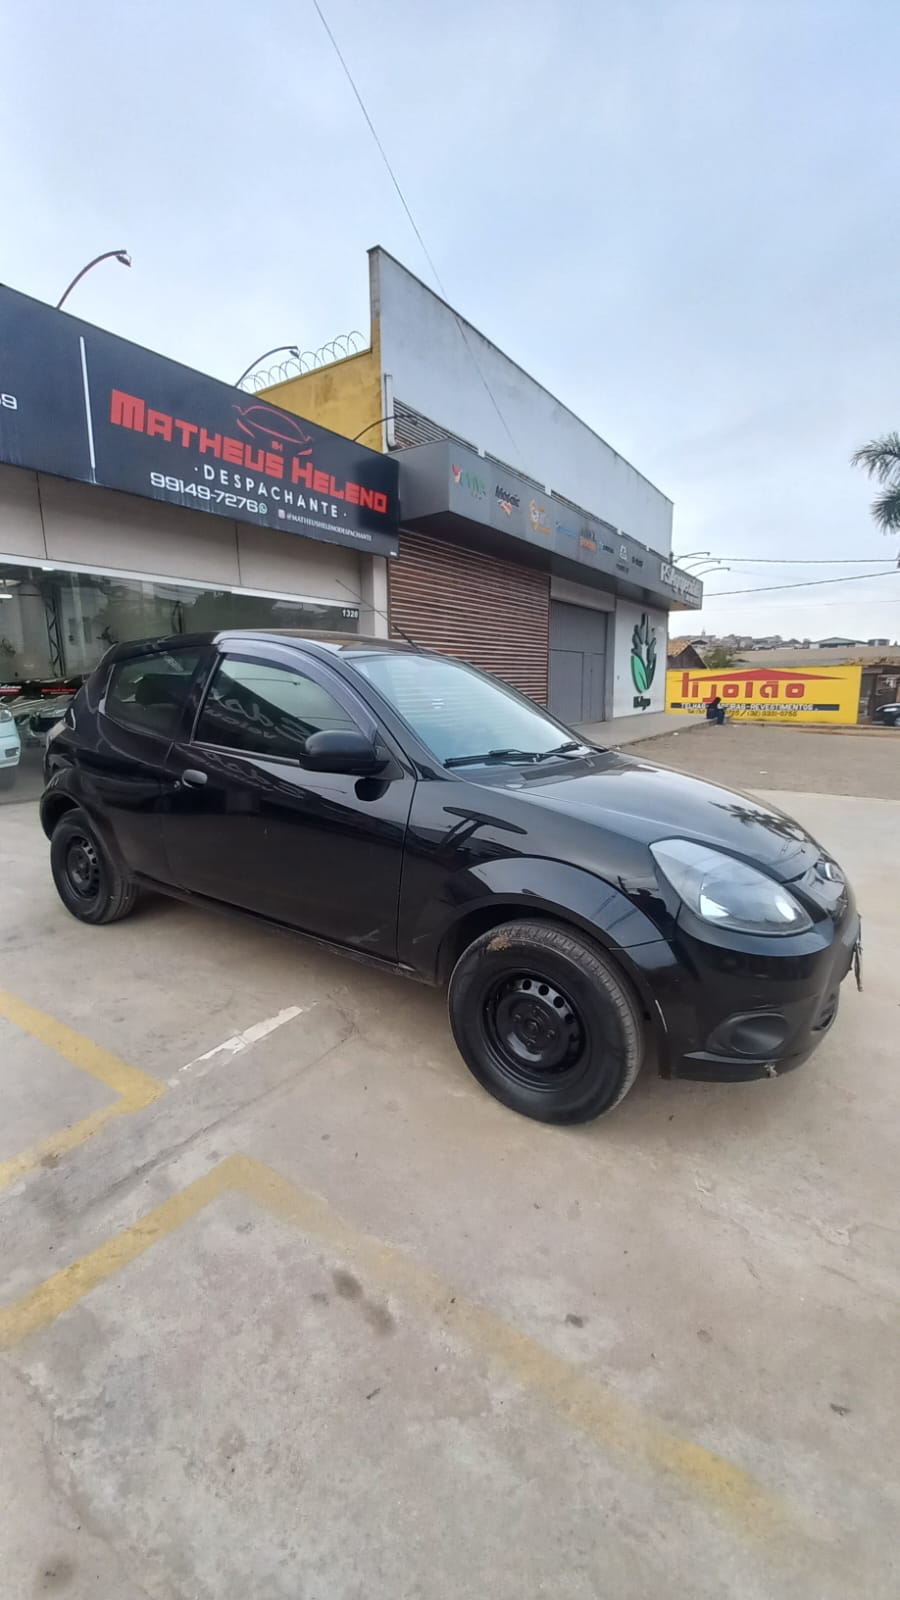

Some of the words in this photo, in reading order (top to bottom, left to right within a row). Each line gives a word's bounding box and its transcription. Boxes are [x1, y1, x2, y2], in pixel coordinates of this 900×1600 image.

[0, 393, 18, 410] 9
[110, 388, 284, 479] MATHEUS
[291, 456, 387, 513] HELENO
[150, 471, 259, 513] 99149-7276
[203, 463, 338, 518] DESPACHANTE
